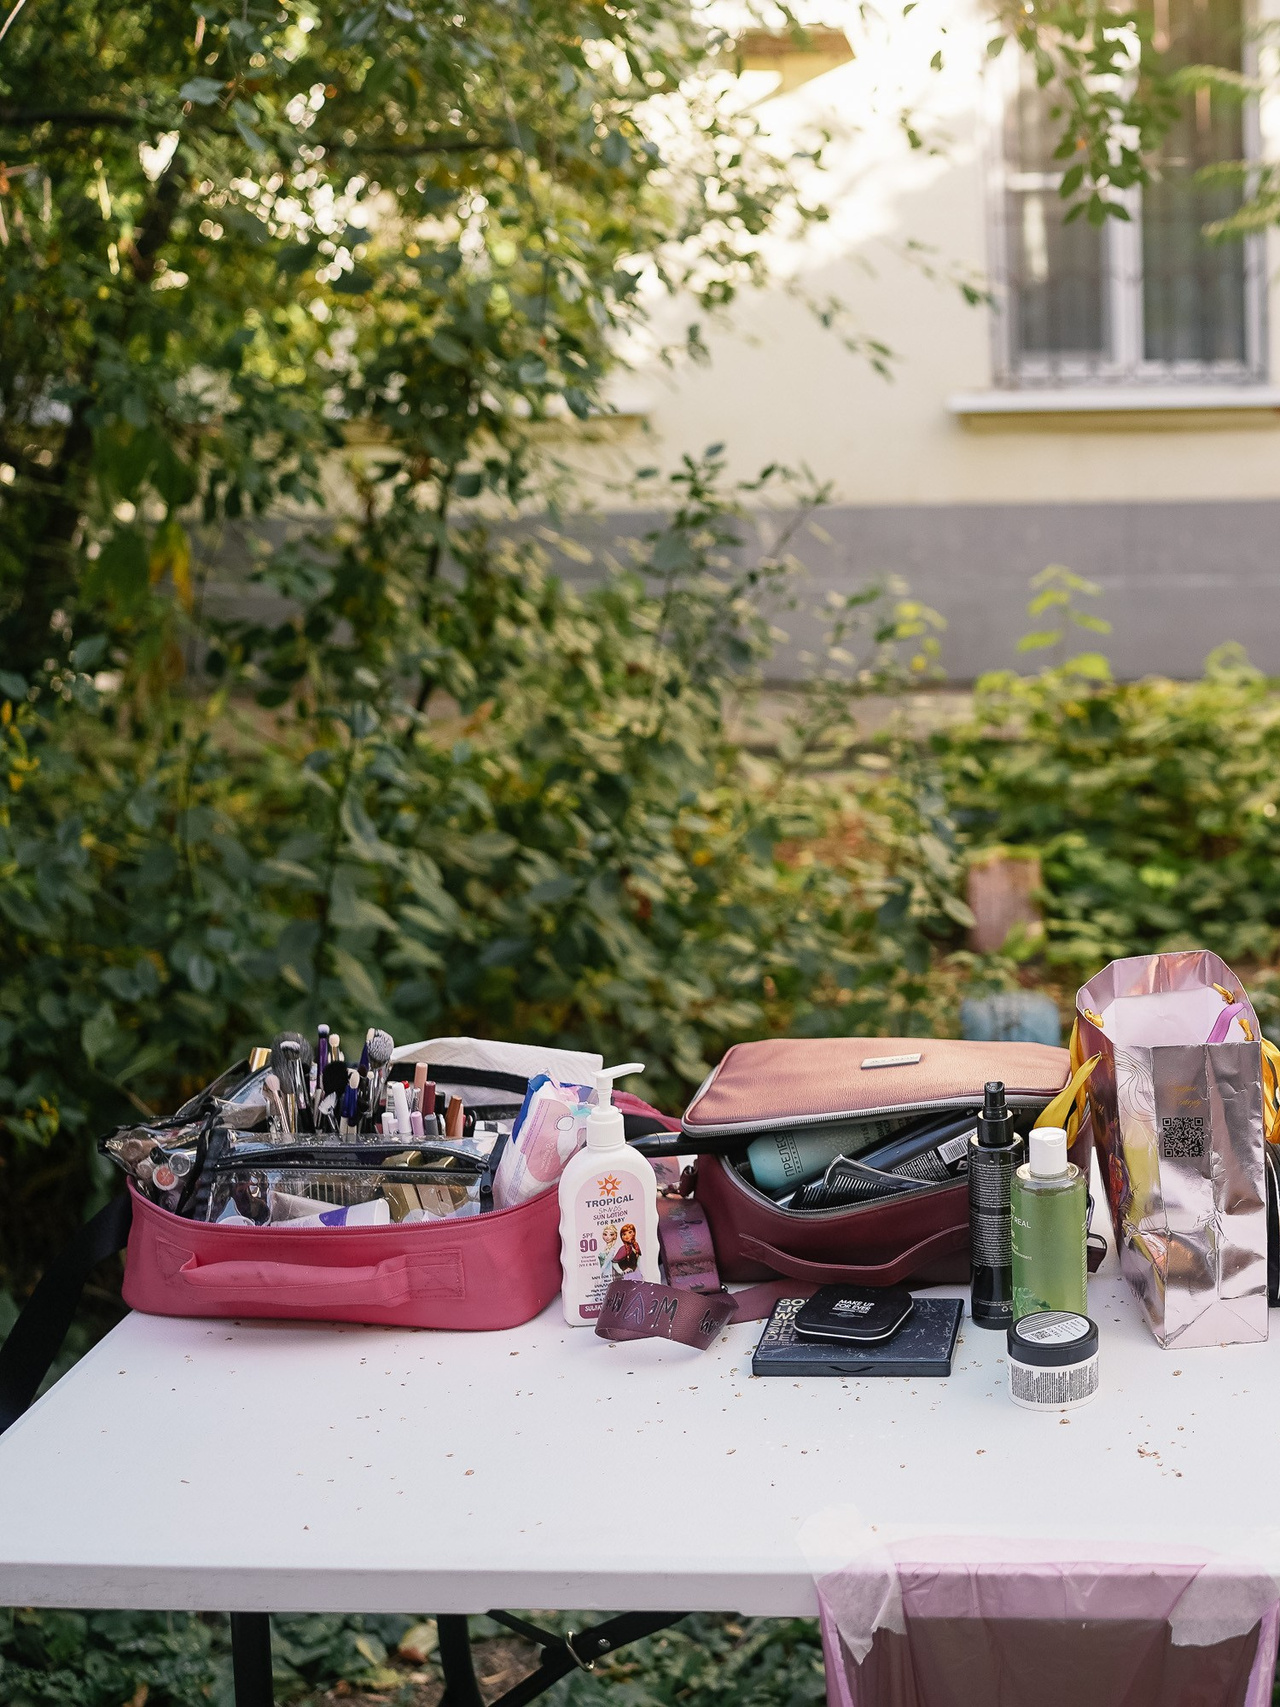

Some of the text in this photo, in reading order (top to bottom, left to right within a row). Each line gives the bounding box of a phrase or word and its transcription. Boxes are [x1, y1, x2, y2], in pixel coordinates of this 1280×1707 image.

[585, 1194, 634, 1208] TROPICAL
[606, 1210, 628, 1219] LOTION
[1014, 1216, 1031, 1229] REAL
[579, 1238, 598, 1253] 90
